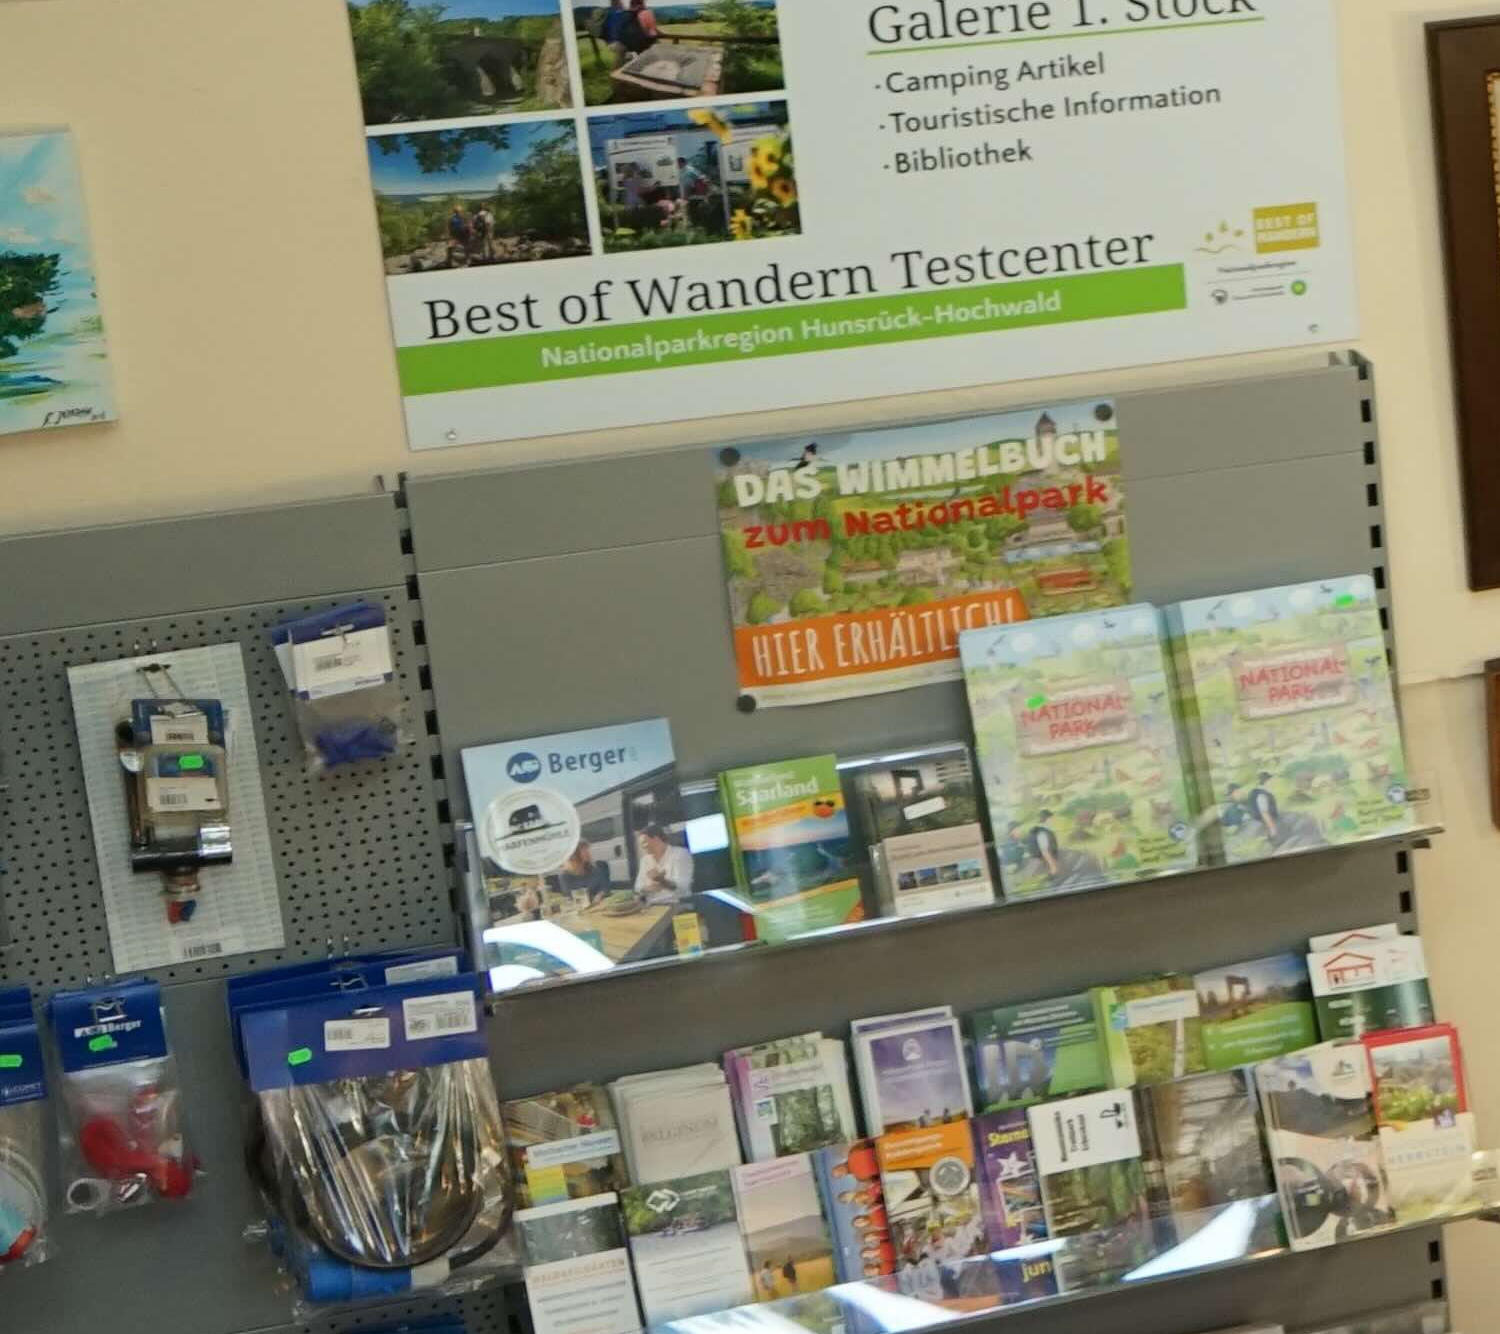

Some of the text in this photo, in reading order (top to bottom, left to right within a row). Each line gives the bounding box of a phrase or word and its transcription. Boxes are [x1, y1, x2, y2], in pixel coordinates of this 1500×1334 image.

[885, 52, 1105, 101] Camping Artikel
[890, 82, 1221, 135] Touristische Information
[894, 140, 1034, 175] Bibliothek
[424, 226, 1155, 341] Best of Wandern Testcenter
[541, 288, 1061, 373] Nationalparkregion Hunsrück-Hochwald
[734, 430, 1105, 508] DAS WIMMELBUCH
[744, 475, 1111, 549] zum Nationalpark
[753, 631, 825, 679] HIER
[547, 746, 627, 774] Berger
[737, 776, 819, 806] Saarland
